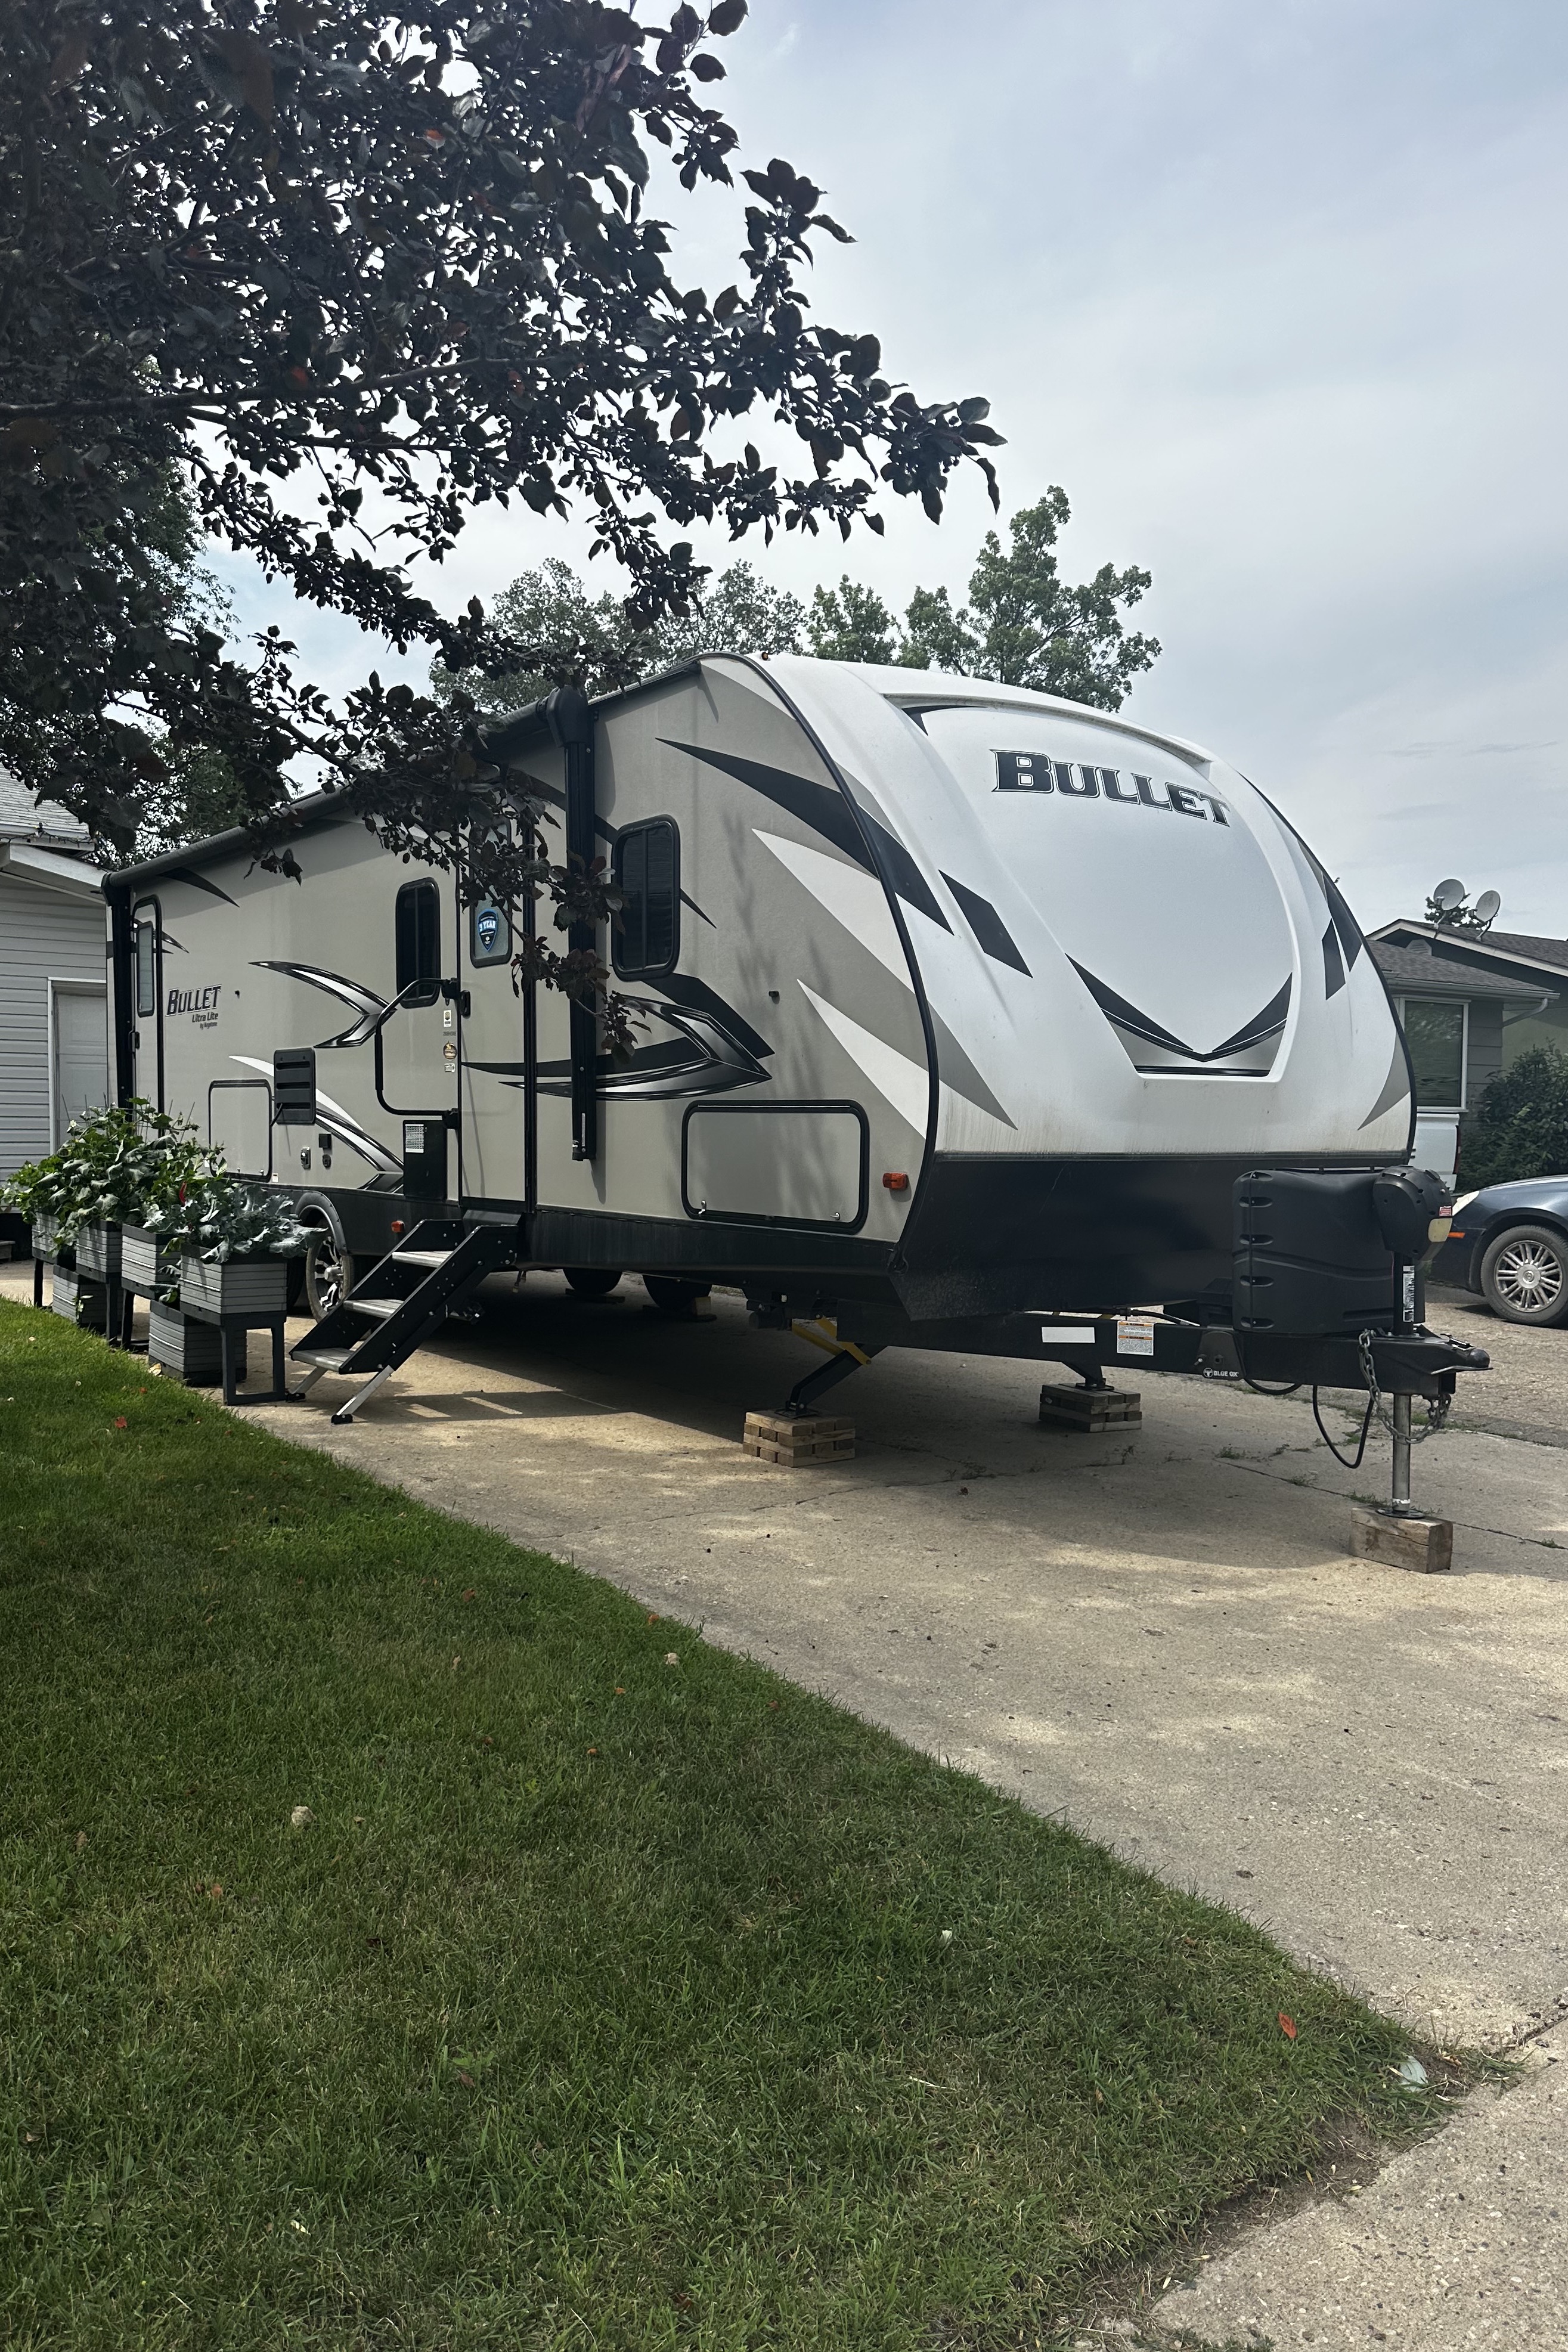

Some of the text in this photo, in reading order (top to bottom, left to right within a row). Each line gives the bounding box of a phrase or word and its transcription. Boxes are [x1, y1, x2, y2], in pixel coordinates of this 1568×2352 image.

[989, 749, 1231, 828] BULLET
[483, 920, 496, 929] YEAR
[166, 984, 222, 1017] BULLET
[192, 1012, 219, 1022] Ultra Lite
